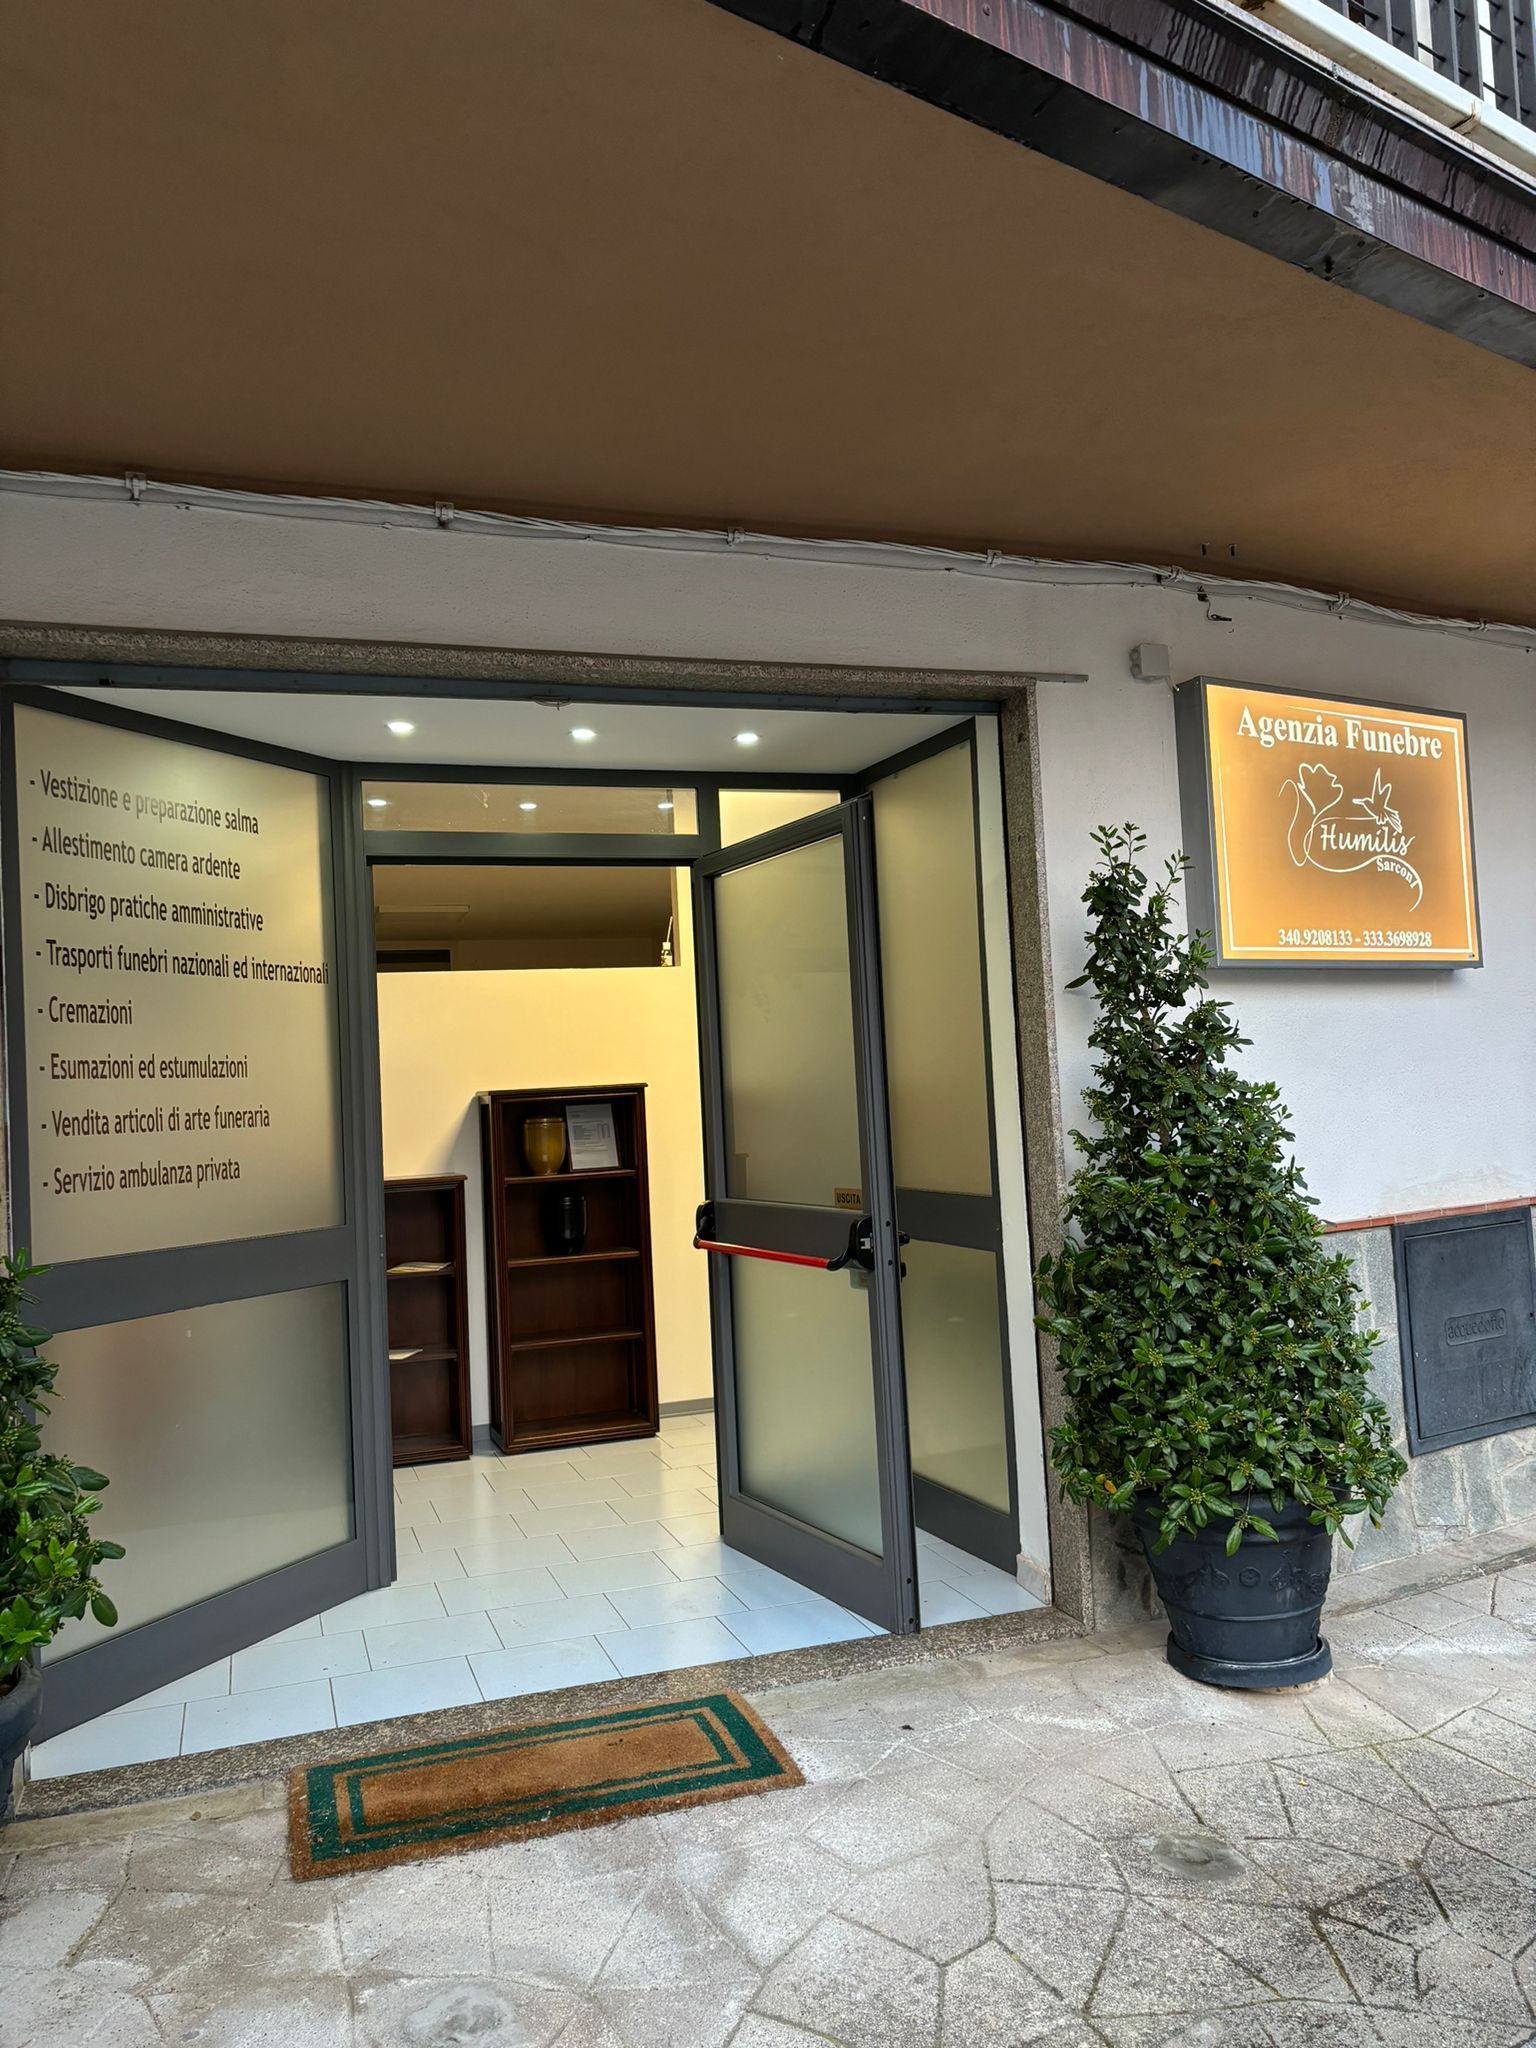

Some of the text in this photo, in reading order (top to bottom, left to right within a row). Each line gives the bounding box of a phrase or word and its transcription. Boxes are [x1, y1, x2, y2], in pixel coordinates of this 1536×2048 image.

[1237, 706, 1443, 759] Agenzia Funebre
[40, 769, 118, 808] Vestizione
[123, 792, 131, 811] e
[136, 795, 221, 827] preparazione
[225, 808, 259, 834] salma
[42, 826, 135, 864] Allestimento
[140, 848, 188, 872] camera
[192, 852, 240, 880] ardente
[1320, 824, 1416, 856] Humilis
[45, 882, 105, 920] Disbrigo
[110, 894, 167, 922] pratiche
[172, 904, 263, 931] amministrative
[1278, 929, 1352, 945] 340.9208133
[1363, 930, 1432, 947] 333.3698928
[46, 939, 113, 974] Trasporti
[117, 945, 168, 973] funebri
[172, 952, 229, 977] nazionali
[233, 957, 248, 979] ed
[251, 960, 329, 984] internazionali
[49, 996, 132, 1024] Cremazioni
[51, 1053, 134, 1079] Esumazioni
[138, 1053, 155, 1079] ed
[160, 1054, 248, 1079] estumulazioni
[51, 1109, 110, 1137] Vendita
[114, 1107, 163, 1134] articoli
[168, 1106, 180, 1131] di
[184, 1108, 211, 1131] arte
[214, 1104, 270, 1129] funeraria
[54, 1165, 115, 1195] Servizio
[120, 1160, 193, 1189] ambulanza
[197, 1157, 240, 1188] privata
[836, 1192, 861, 1204] USCITA
